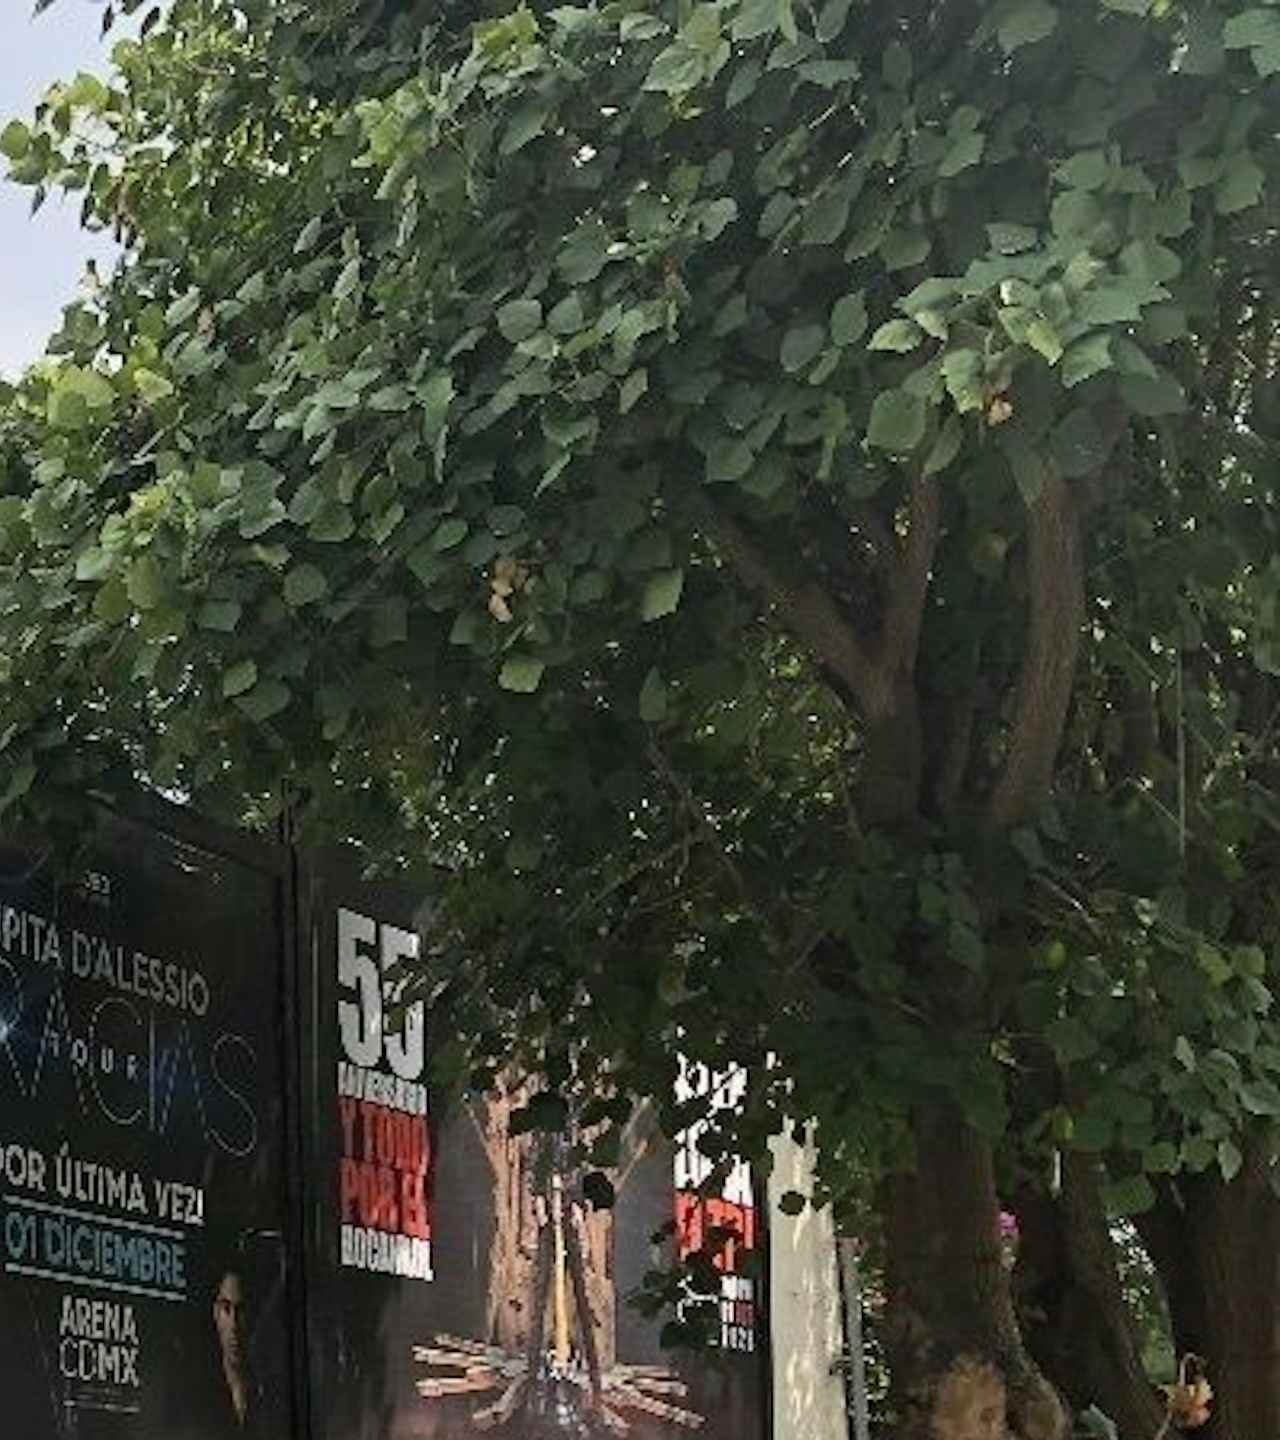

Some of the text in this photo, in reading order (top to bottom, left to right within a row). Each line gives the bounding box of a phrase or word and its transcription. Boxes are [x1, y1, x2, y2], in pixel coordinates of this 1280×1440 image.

[72, 929, 210, 1016] D'ALESSIO
[55, 1140, 149, 1215] ÚLTIMA
[154, 1179, 205, 1226] VEZ!
[4, 1211, 188, 1289] 01 DICIEMBRE
[58, 1294, 140, 1346] ARENA
[58, 1336, 140, 1388] CDMX
